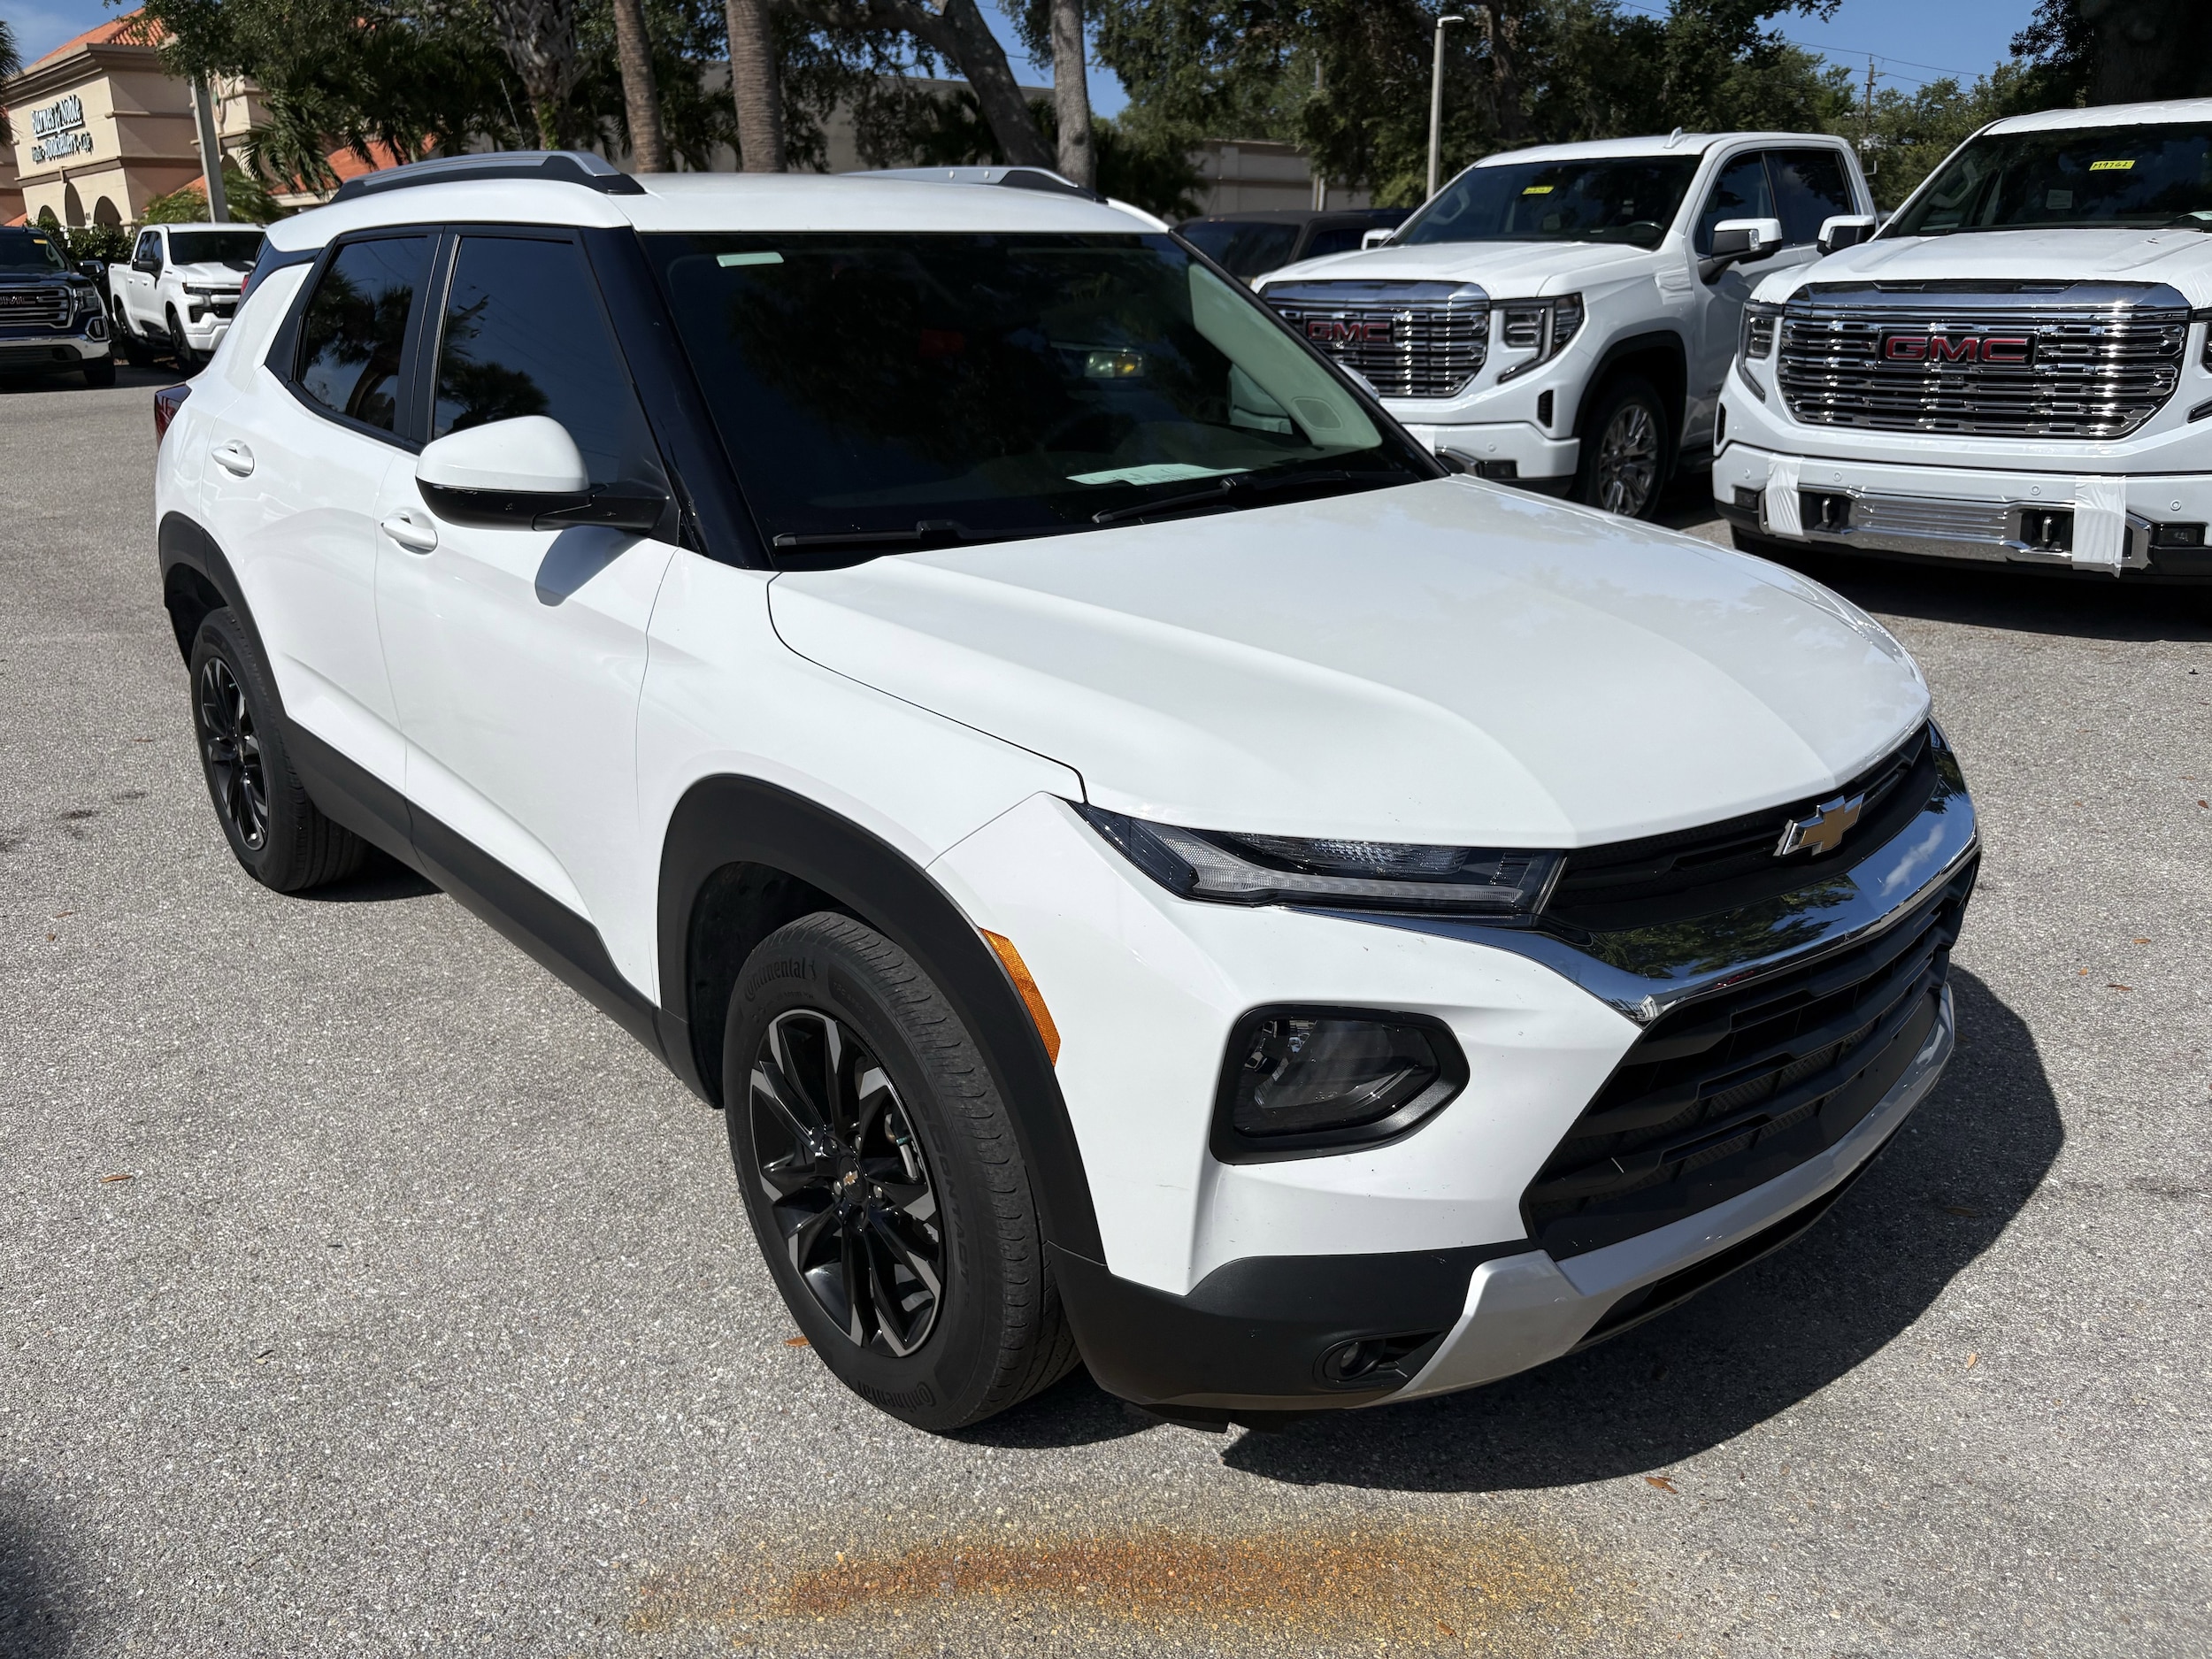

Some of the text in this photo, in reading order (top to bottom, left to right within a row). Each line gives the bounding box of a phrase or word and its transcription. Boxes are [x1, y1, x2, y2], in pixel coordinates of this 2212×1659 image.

[59, 95, 81, 126] Noble
[0, 296, 36, 305] MC
[1308, 321, 1392, 342] GMC
[1886, 335, 2031, 364] GMC
[744, 956, 806, 1002] Continental
[856, 1379, 937, 1413] Continental
